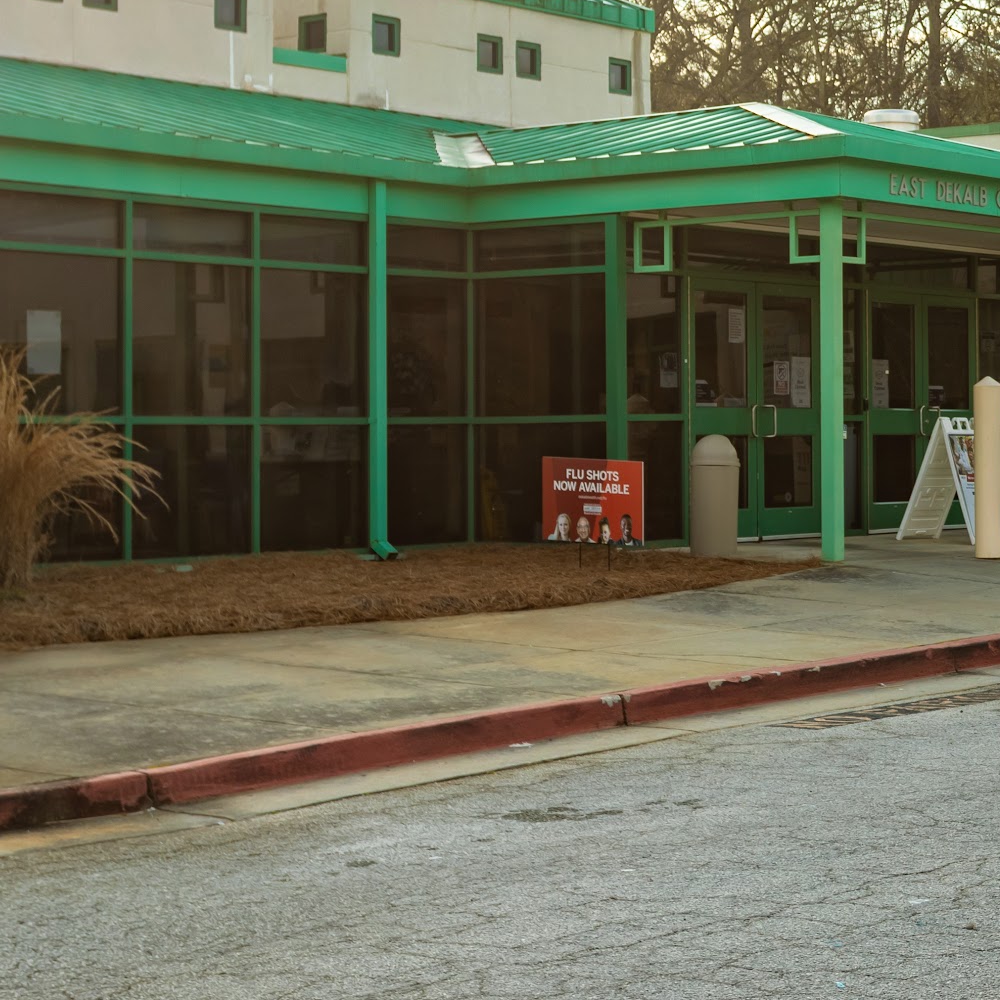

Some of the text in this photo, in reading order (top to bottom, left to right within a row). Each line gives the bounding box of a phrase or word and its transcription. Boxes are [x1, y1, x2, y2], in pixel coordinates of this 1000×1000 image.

[889, 172, 926, 199] EAST
[936, 180, 988, 207] DEKALB
[566, 468, 620, 482] FLU SHOTS
[553, 480, 630, 495] NOW AVAILABLE
